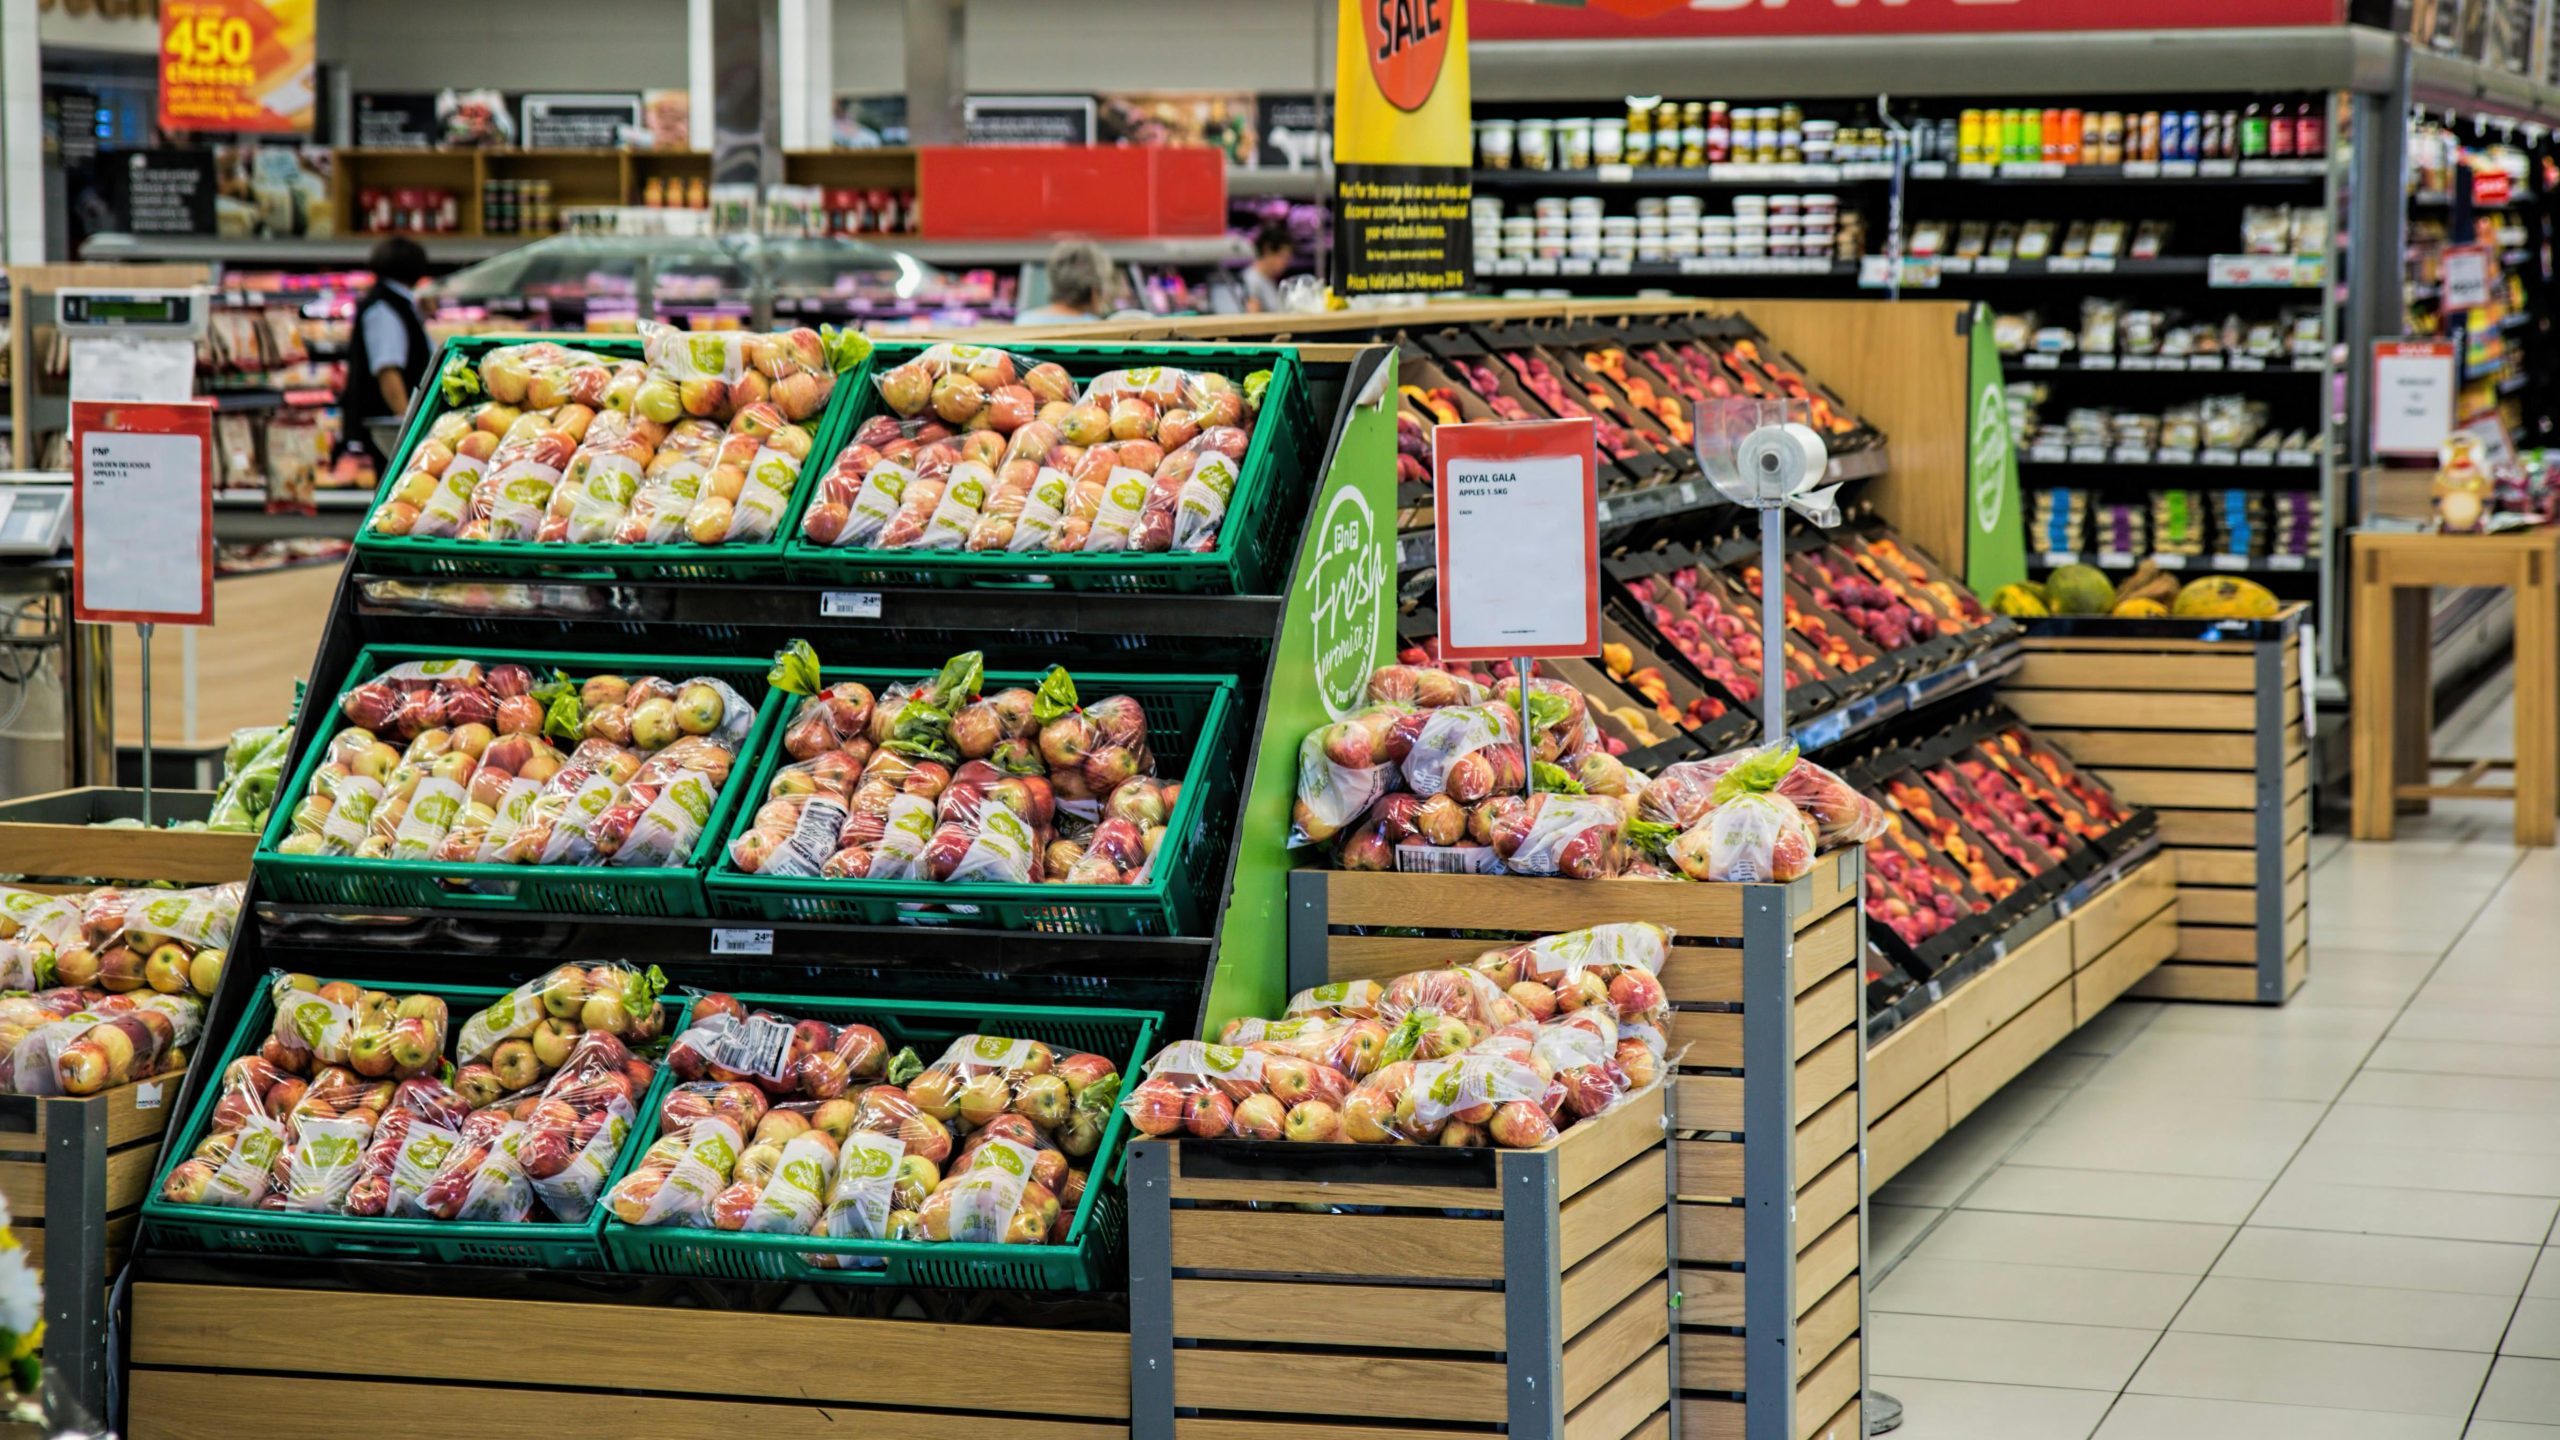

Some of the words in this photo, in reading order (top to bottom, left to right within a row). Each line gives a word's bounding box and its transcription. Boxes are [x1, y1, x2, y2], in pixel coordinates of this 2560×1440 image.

[165, 16, 252, 65] 450
[165, 62, 256, 86] cheeses
[92, 447, 110, 456] PNP
[1459, 473, 1489, 484] ROYAL
[1491, 472, 1517, 483] GALA
[1459, 488, 1485, 497] APPLES
[1333, 519, 1360, 555] PnP
[1305, 509, 1388, 640] Fresh
[1320, 623, 1364, 701] promise
